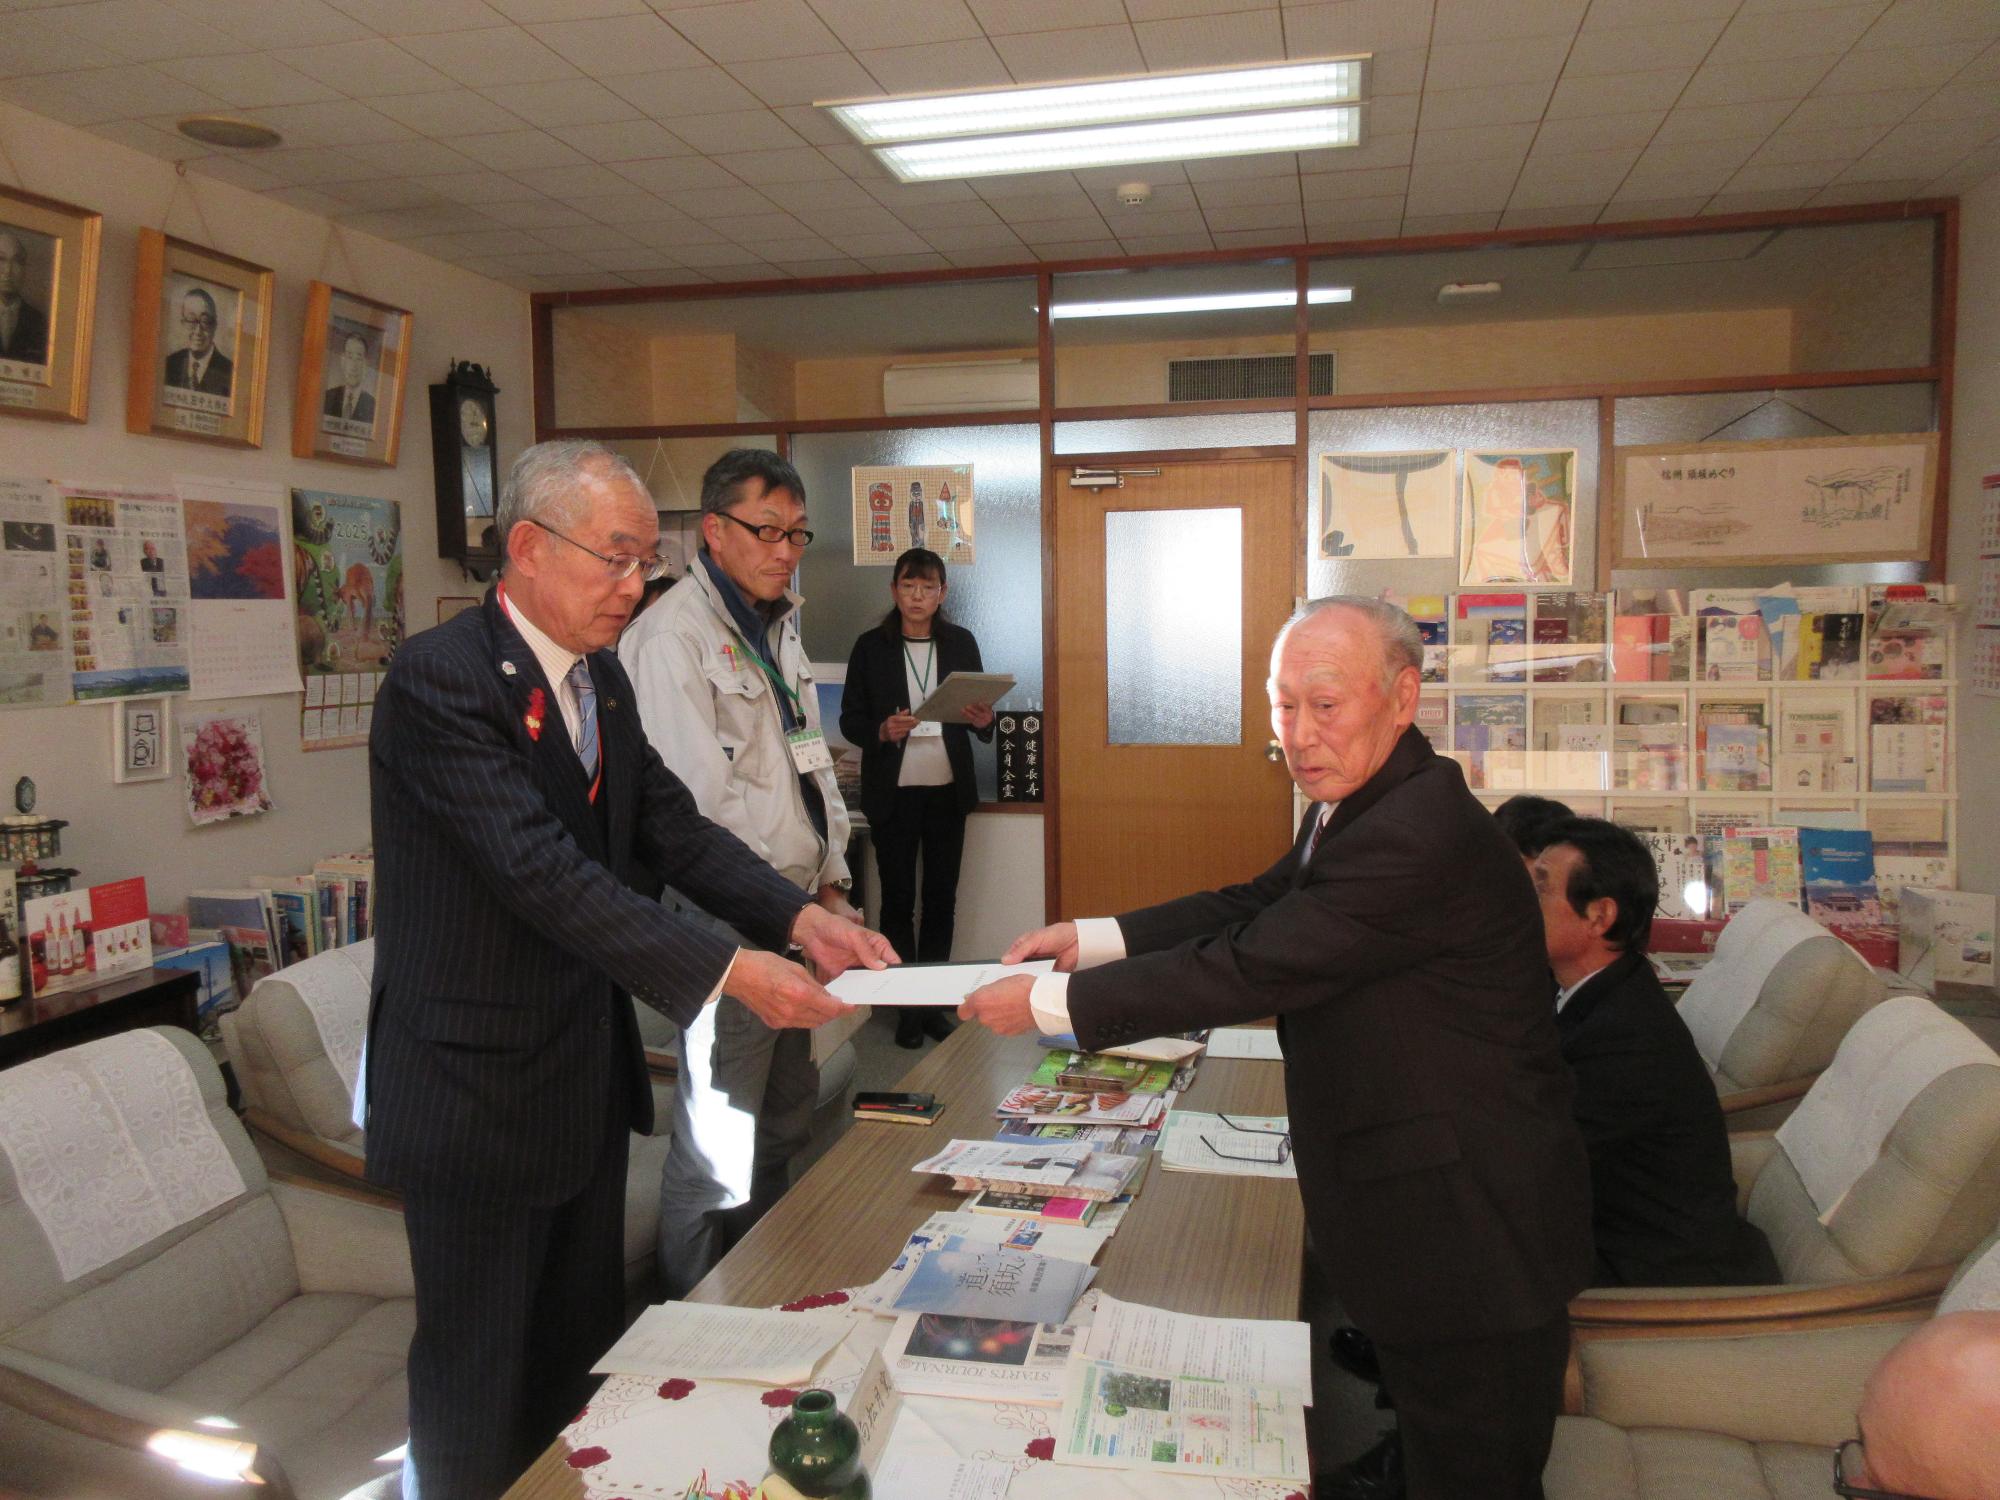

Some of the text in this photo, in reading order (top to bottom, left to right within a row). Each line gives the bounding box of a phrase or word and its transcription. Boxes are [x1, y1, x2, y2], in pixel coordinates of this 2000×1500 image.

[1025, 740, 1040, 796] 健康長寿
[911, 1361, 1051, 1382] STARTS JOURNAL
